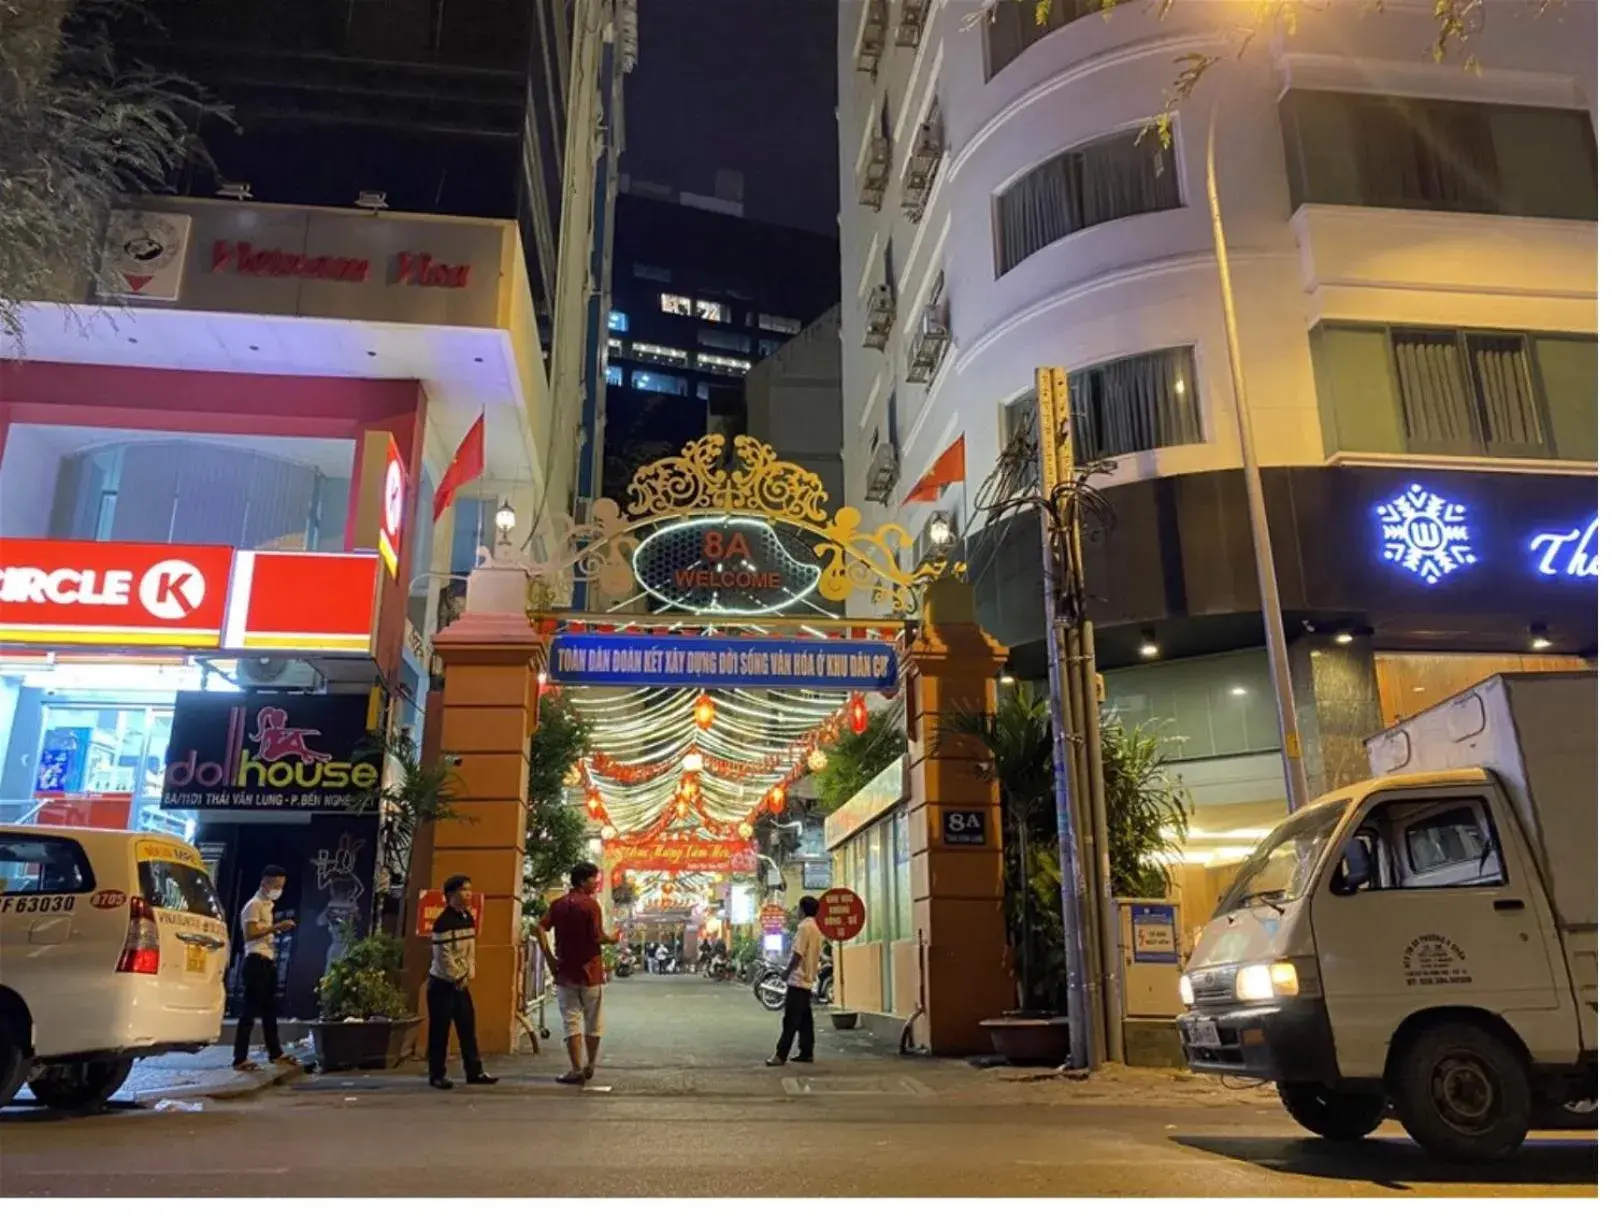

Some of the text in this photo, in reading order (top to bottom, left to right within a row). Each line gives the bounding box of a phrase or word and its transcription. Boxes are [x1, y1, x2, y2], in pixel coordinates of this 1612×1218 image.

[703, 529, 752, 559] 8A
[674, 571, 782, 588] WELCOME
[558, 645, 586, 672] TOÀN
[588, 645, 611, 672] DÂN
[644, 645, 663, 673] KẾT
[740, 646, 769, 675] SỐNG
[826, 654, 848, 677] KHU
[850, 651, 871, 677] DÂN
[164, 706, 378, 788] dollhouse
[255, 793, 283, 806] LUNG
[948, 813, 980, 832] 8A
[15, 896, 76, 913] 63030
